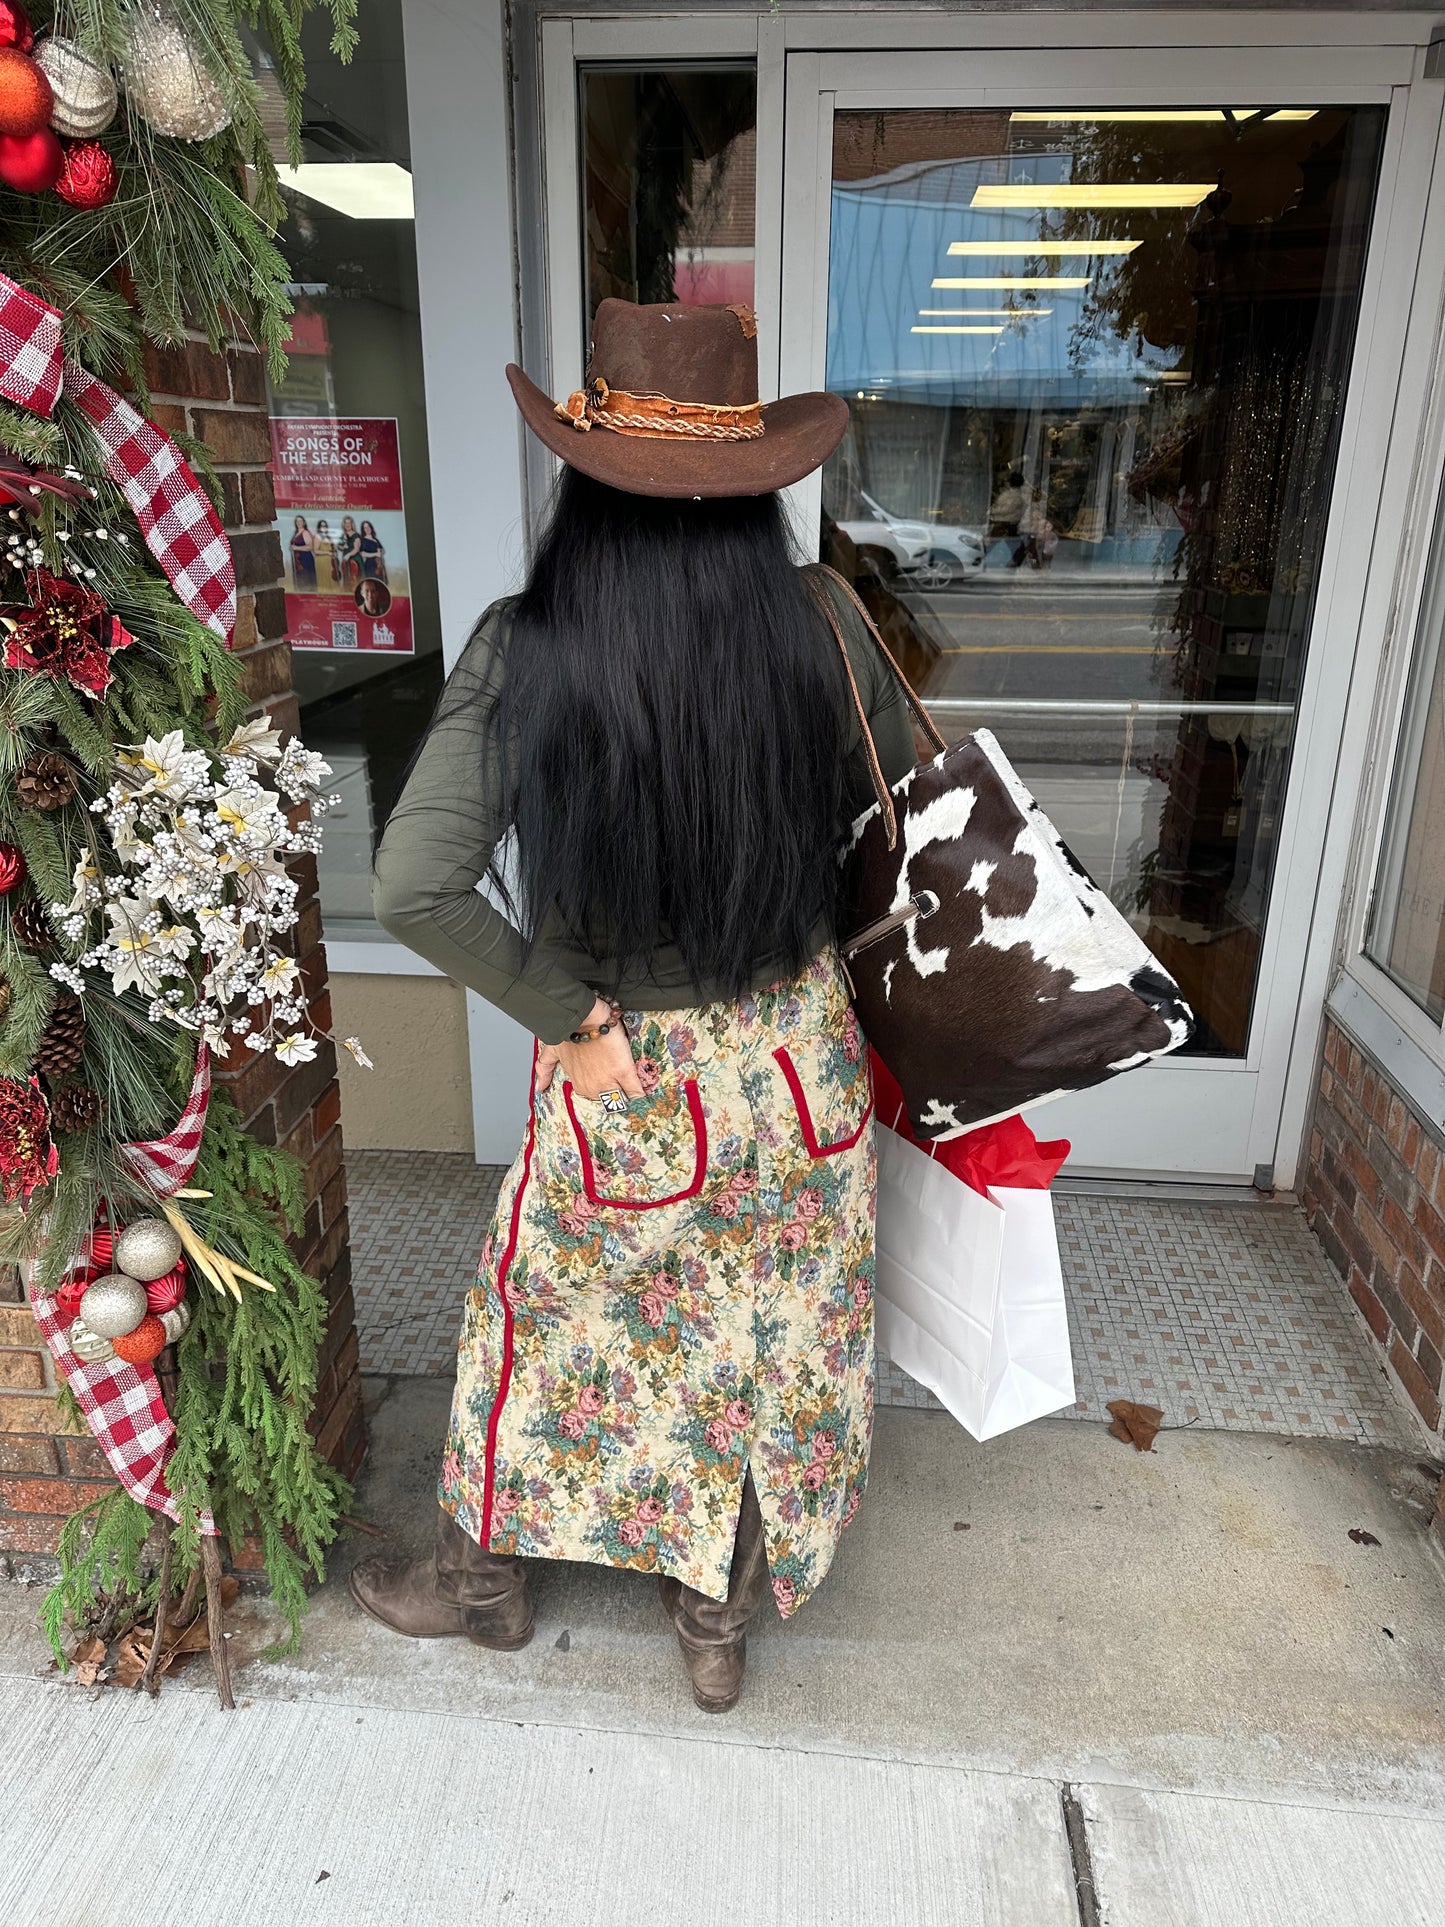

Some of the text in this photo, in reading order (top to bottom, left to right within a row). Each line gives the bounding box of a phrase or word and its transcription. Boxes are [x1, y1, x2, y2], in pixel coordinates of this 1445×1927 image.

[286, 437, 364, 451] SONGS OF
[280, 451, 372, 465] THE SEASON
